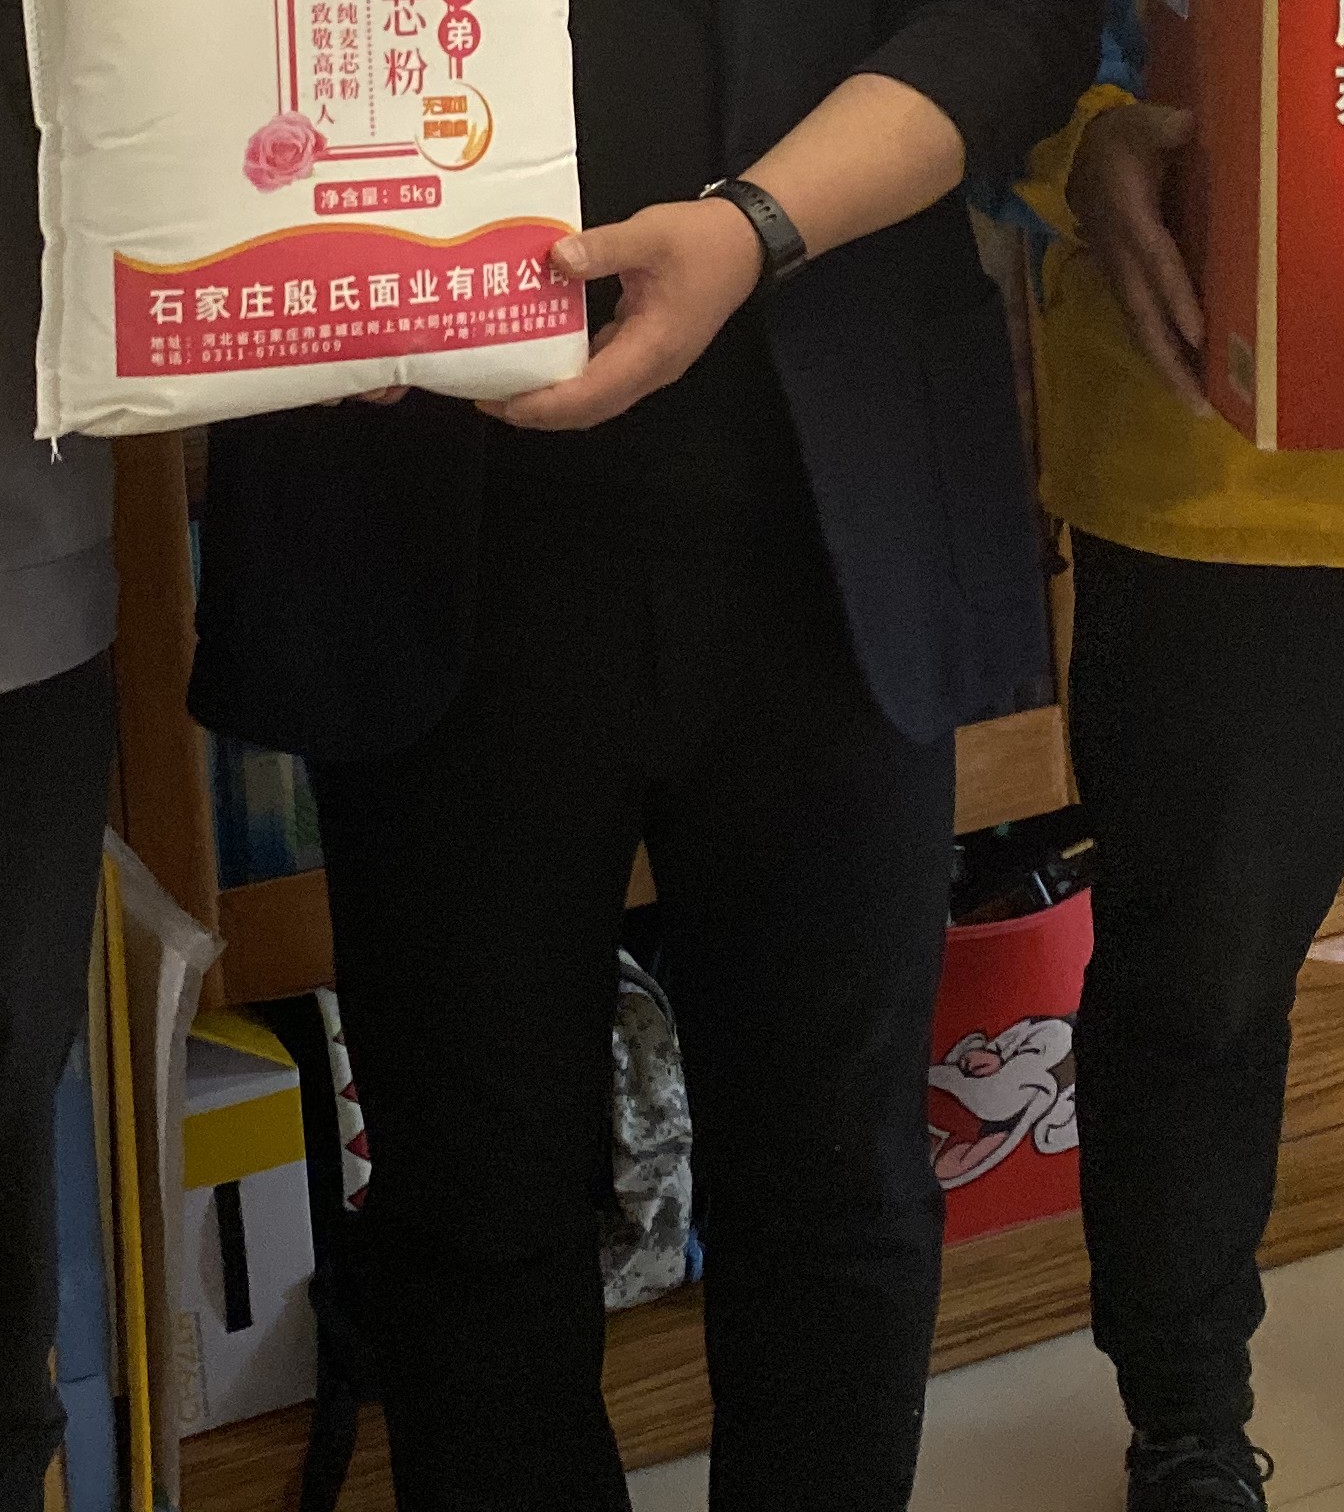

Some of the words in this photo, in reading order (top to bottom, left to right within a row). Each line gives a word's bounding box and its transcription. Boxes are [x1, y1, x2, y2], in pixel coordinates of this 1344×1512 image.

[310, 1, 337, 126] 致敬高尚人
